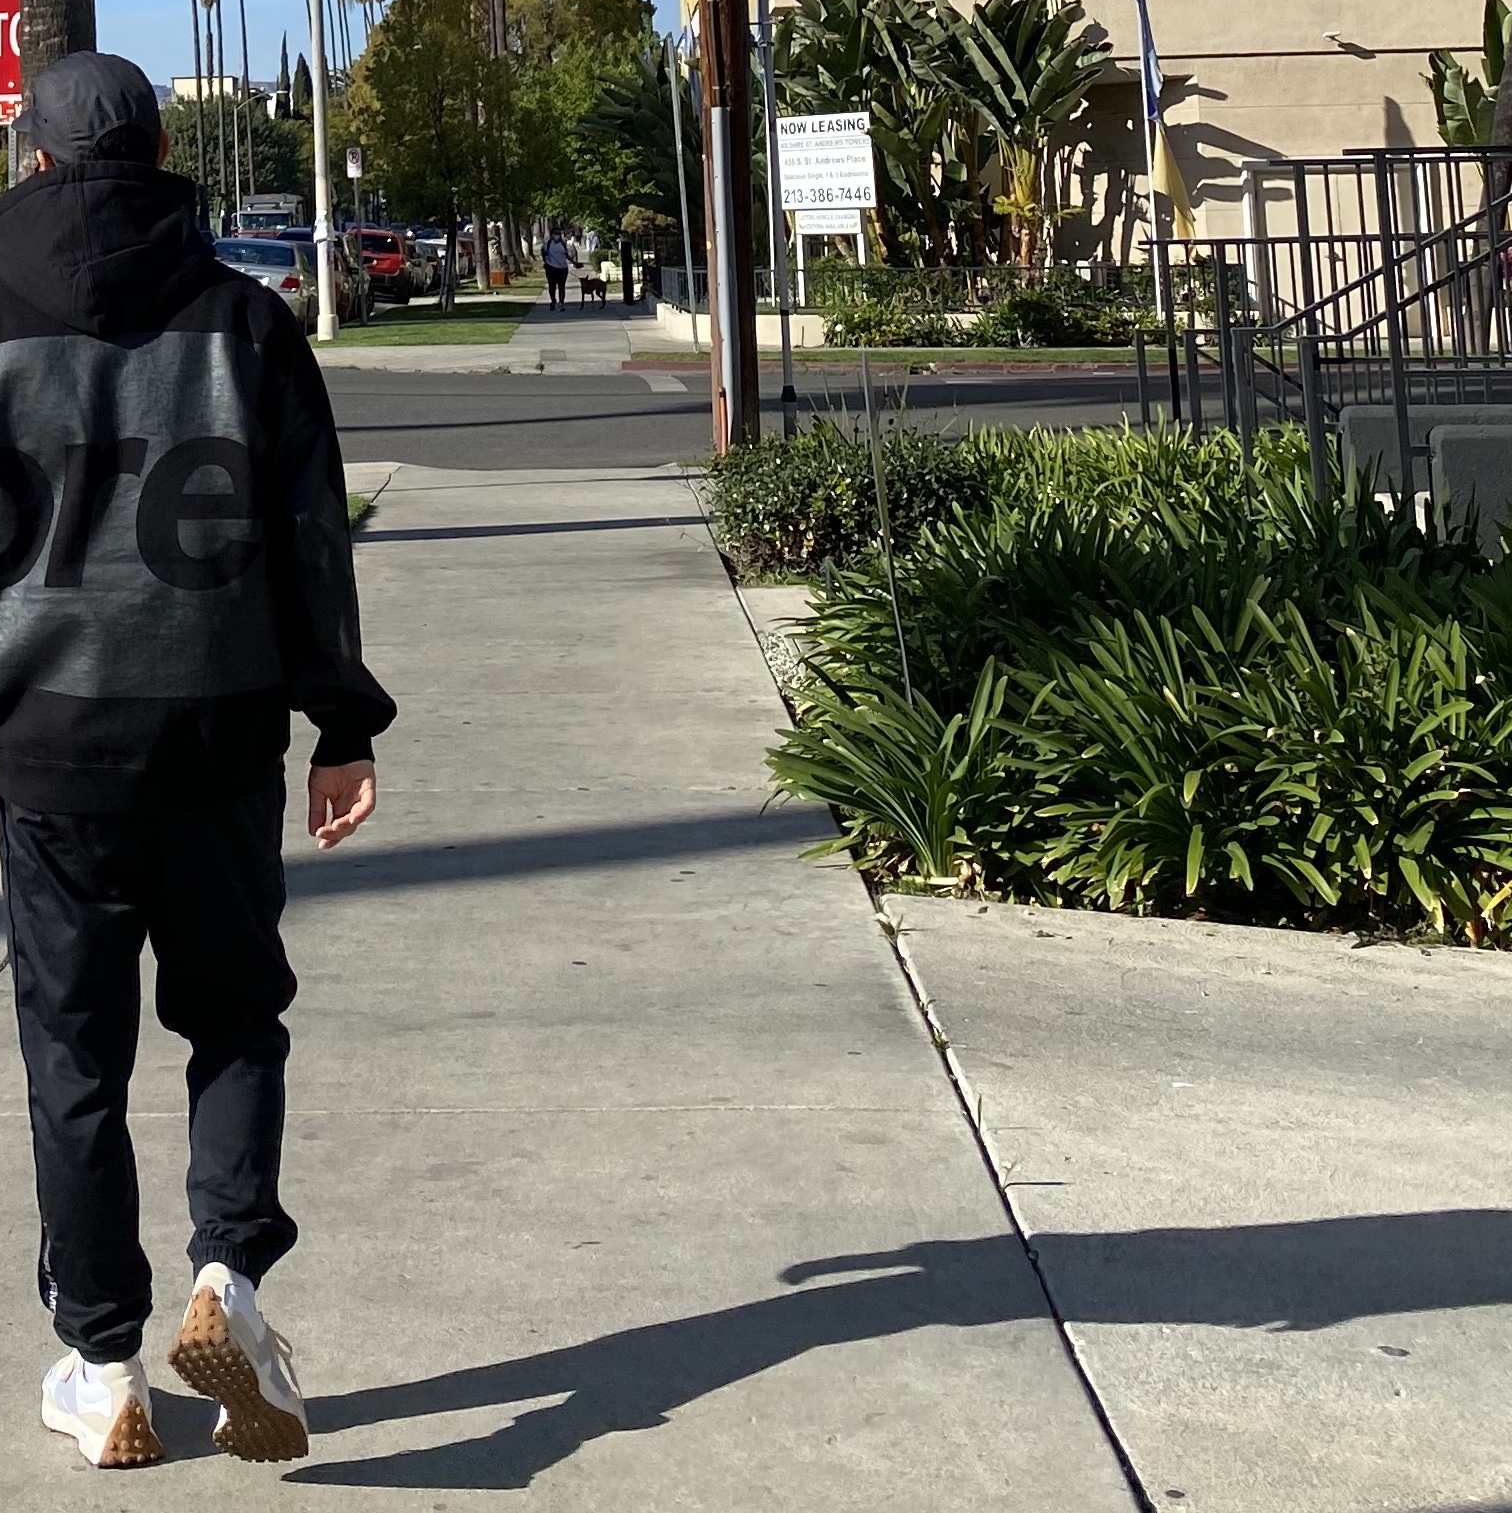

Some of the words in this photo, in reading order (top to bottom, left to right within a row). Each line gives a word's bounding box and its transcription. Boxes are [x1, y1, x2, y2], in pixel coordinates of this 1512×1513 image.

[780, 121, 807, 135] NOW
[811, 117, 866, 133] LEASING
[815, 154, 845, 165] Andrews
[846, 153, 867, 164] Place
[783, 186, 871, 204] 213-386-7446
